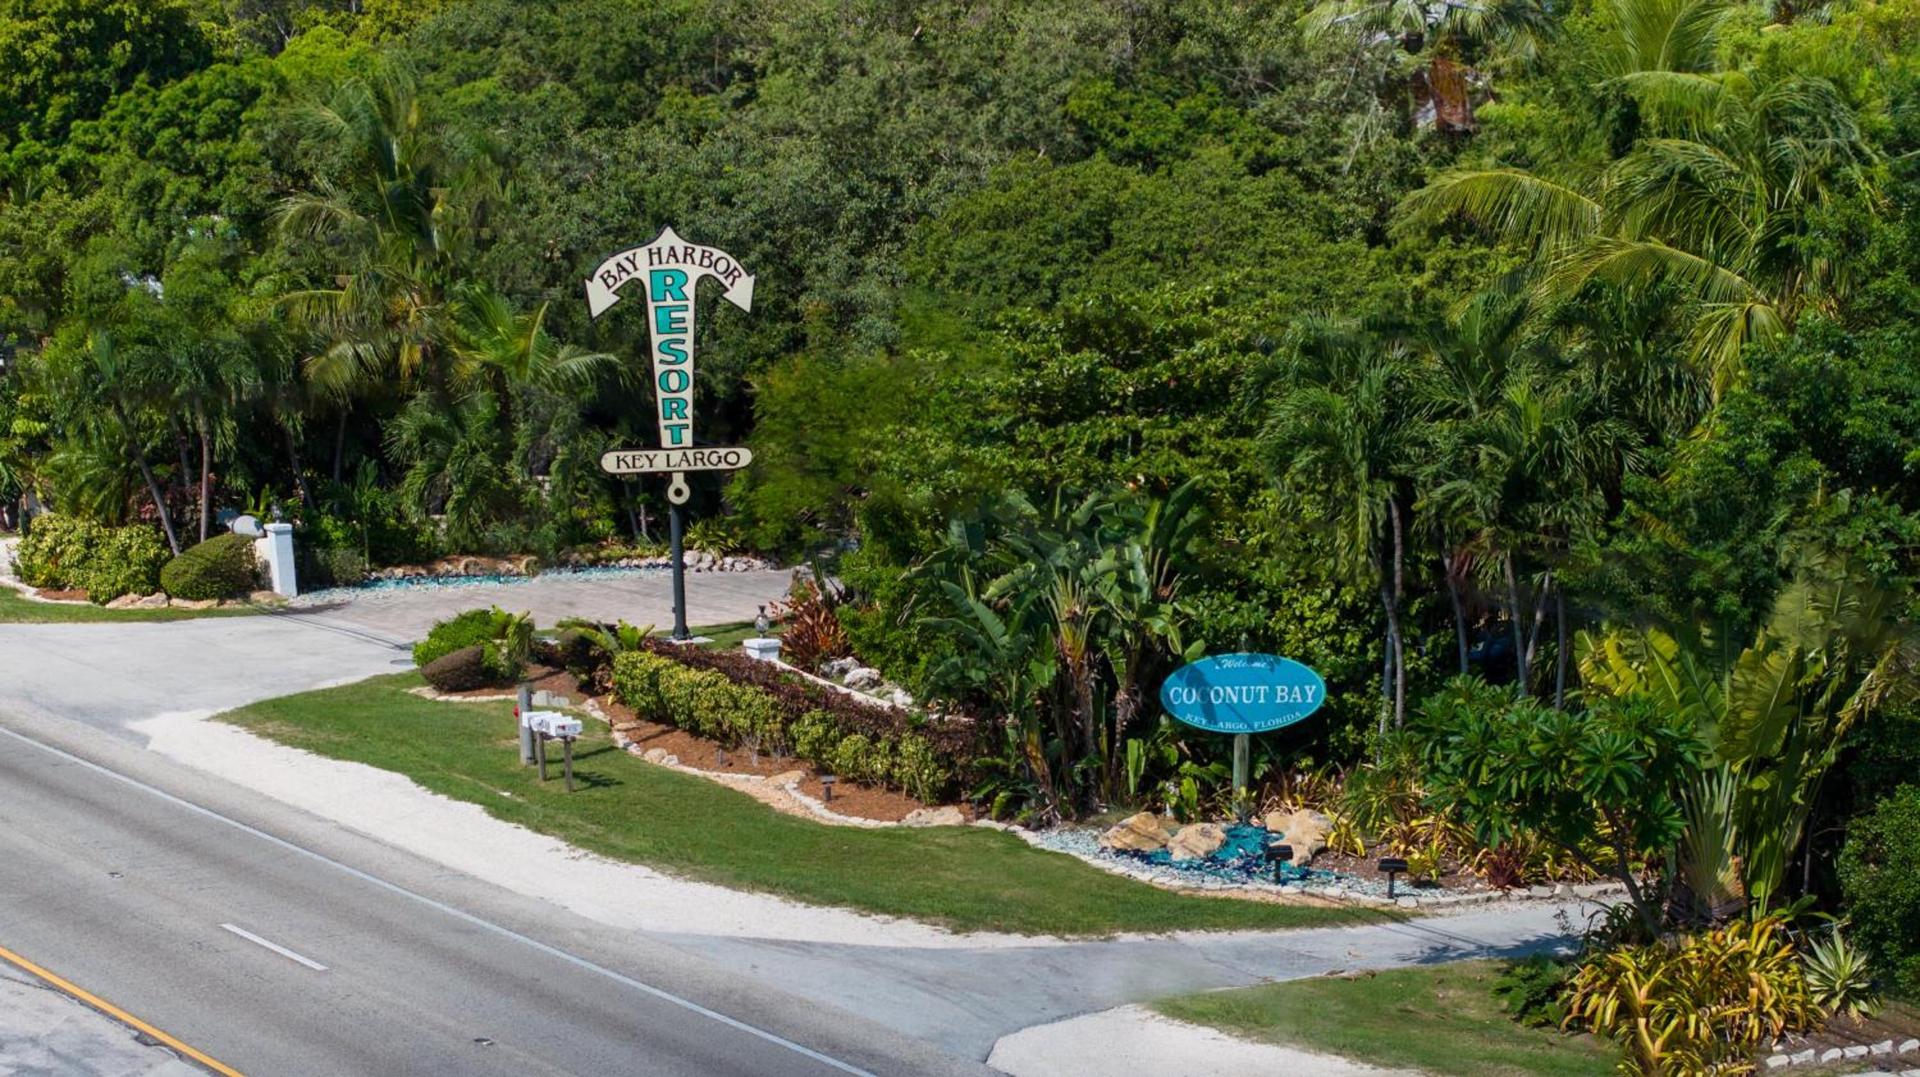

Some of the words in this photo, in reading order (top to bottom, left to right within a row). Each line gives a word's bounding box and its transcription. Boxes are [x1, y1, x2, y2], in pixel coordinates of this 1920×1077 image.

[600, 252, 640, 290] BAY
[648, 246, 742, 287] HARBOR
[649, 268, 690, 445] RESORT
[616, 454, 659, 469] KEY
[666, 450, 740, 468] LARGO
[1169, 686, 1269, 704] COCONUT
[1275, 685, 1317, 703] BAY
[1185, 713, 1208, 726] KEY
[1253, 712, 1301, 729] FLORIDA
